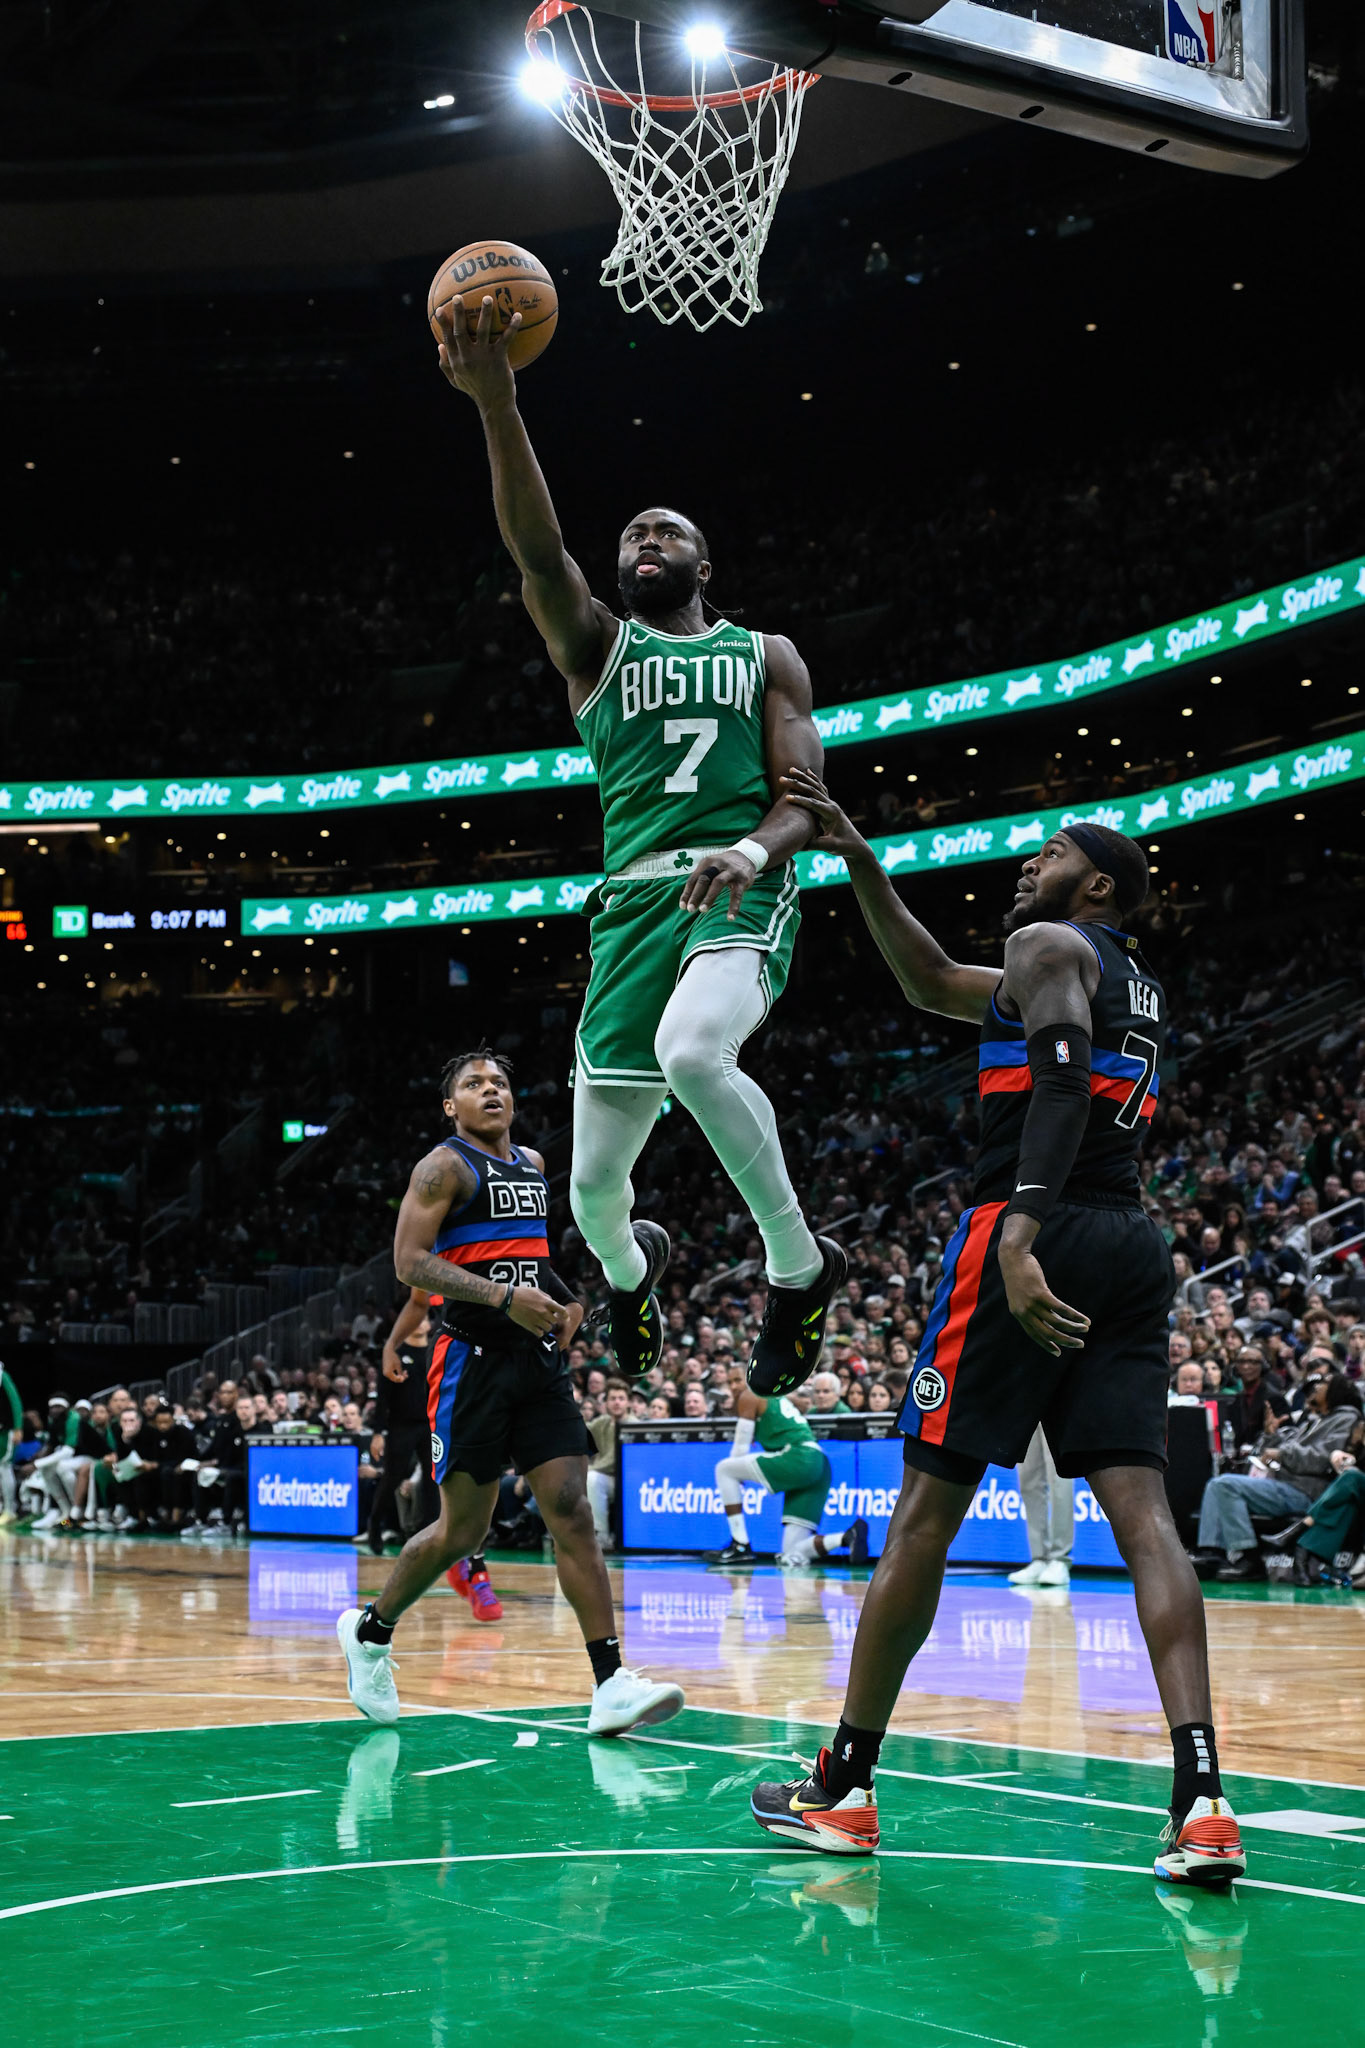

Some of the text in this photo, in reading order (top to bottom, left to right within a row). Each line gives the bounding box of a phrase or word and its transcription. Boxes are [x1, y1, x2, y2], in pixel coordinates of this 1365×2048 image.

[1174, 33, 1199, 61] NBA
[451, 252, 537, 283] Wilson
[712, 639, 751, 648] Amica
[925, 685, 990, 722] Sprite
[1055, 655, 1112, 696] Sprite
[1164, 618, 1222, 661] Sprite
[1279, 577, 1343, 622] Sprite
[620, 655, 756, 721] BOSTON
[664, 718, 718, 793] 7
[24, 753, 595, 815] Sprite Sprite Sprite Sprite Spri
[809, 854, 849, 883] Spri
[929, 828, 993, 863] Sprite
[1178, 779, 1235, 819] Sprite
[1290, 746, 1353, 788] Sprite
[57, 909, 226, 932] TD Bank 9:07 PM
[304, 900, 370, 930] Sprite
[429, 890, 494, 921] Sprite
[1128, 980, 1159, 1022] REED
[1114, 1030, 1158, 1129] 7
[488, 1182, 547, 1218] DET
[489, 1261, 539, 1289] 25
[917, 1378, 940, 1399] DET
[257, 1473, 352, 1508] ticketmaster
[639, 1478, 768, 1515] ticketmaer
